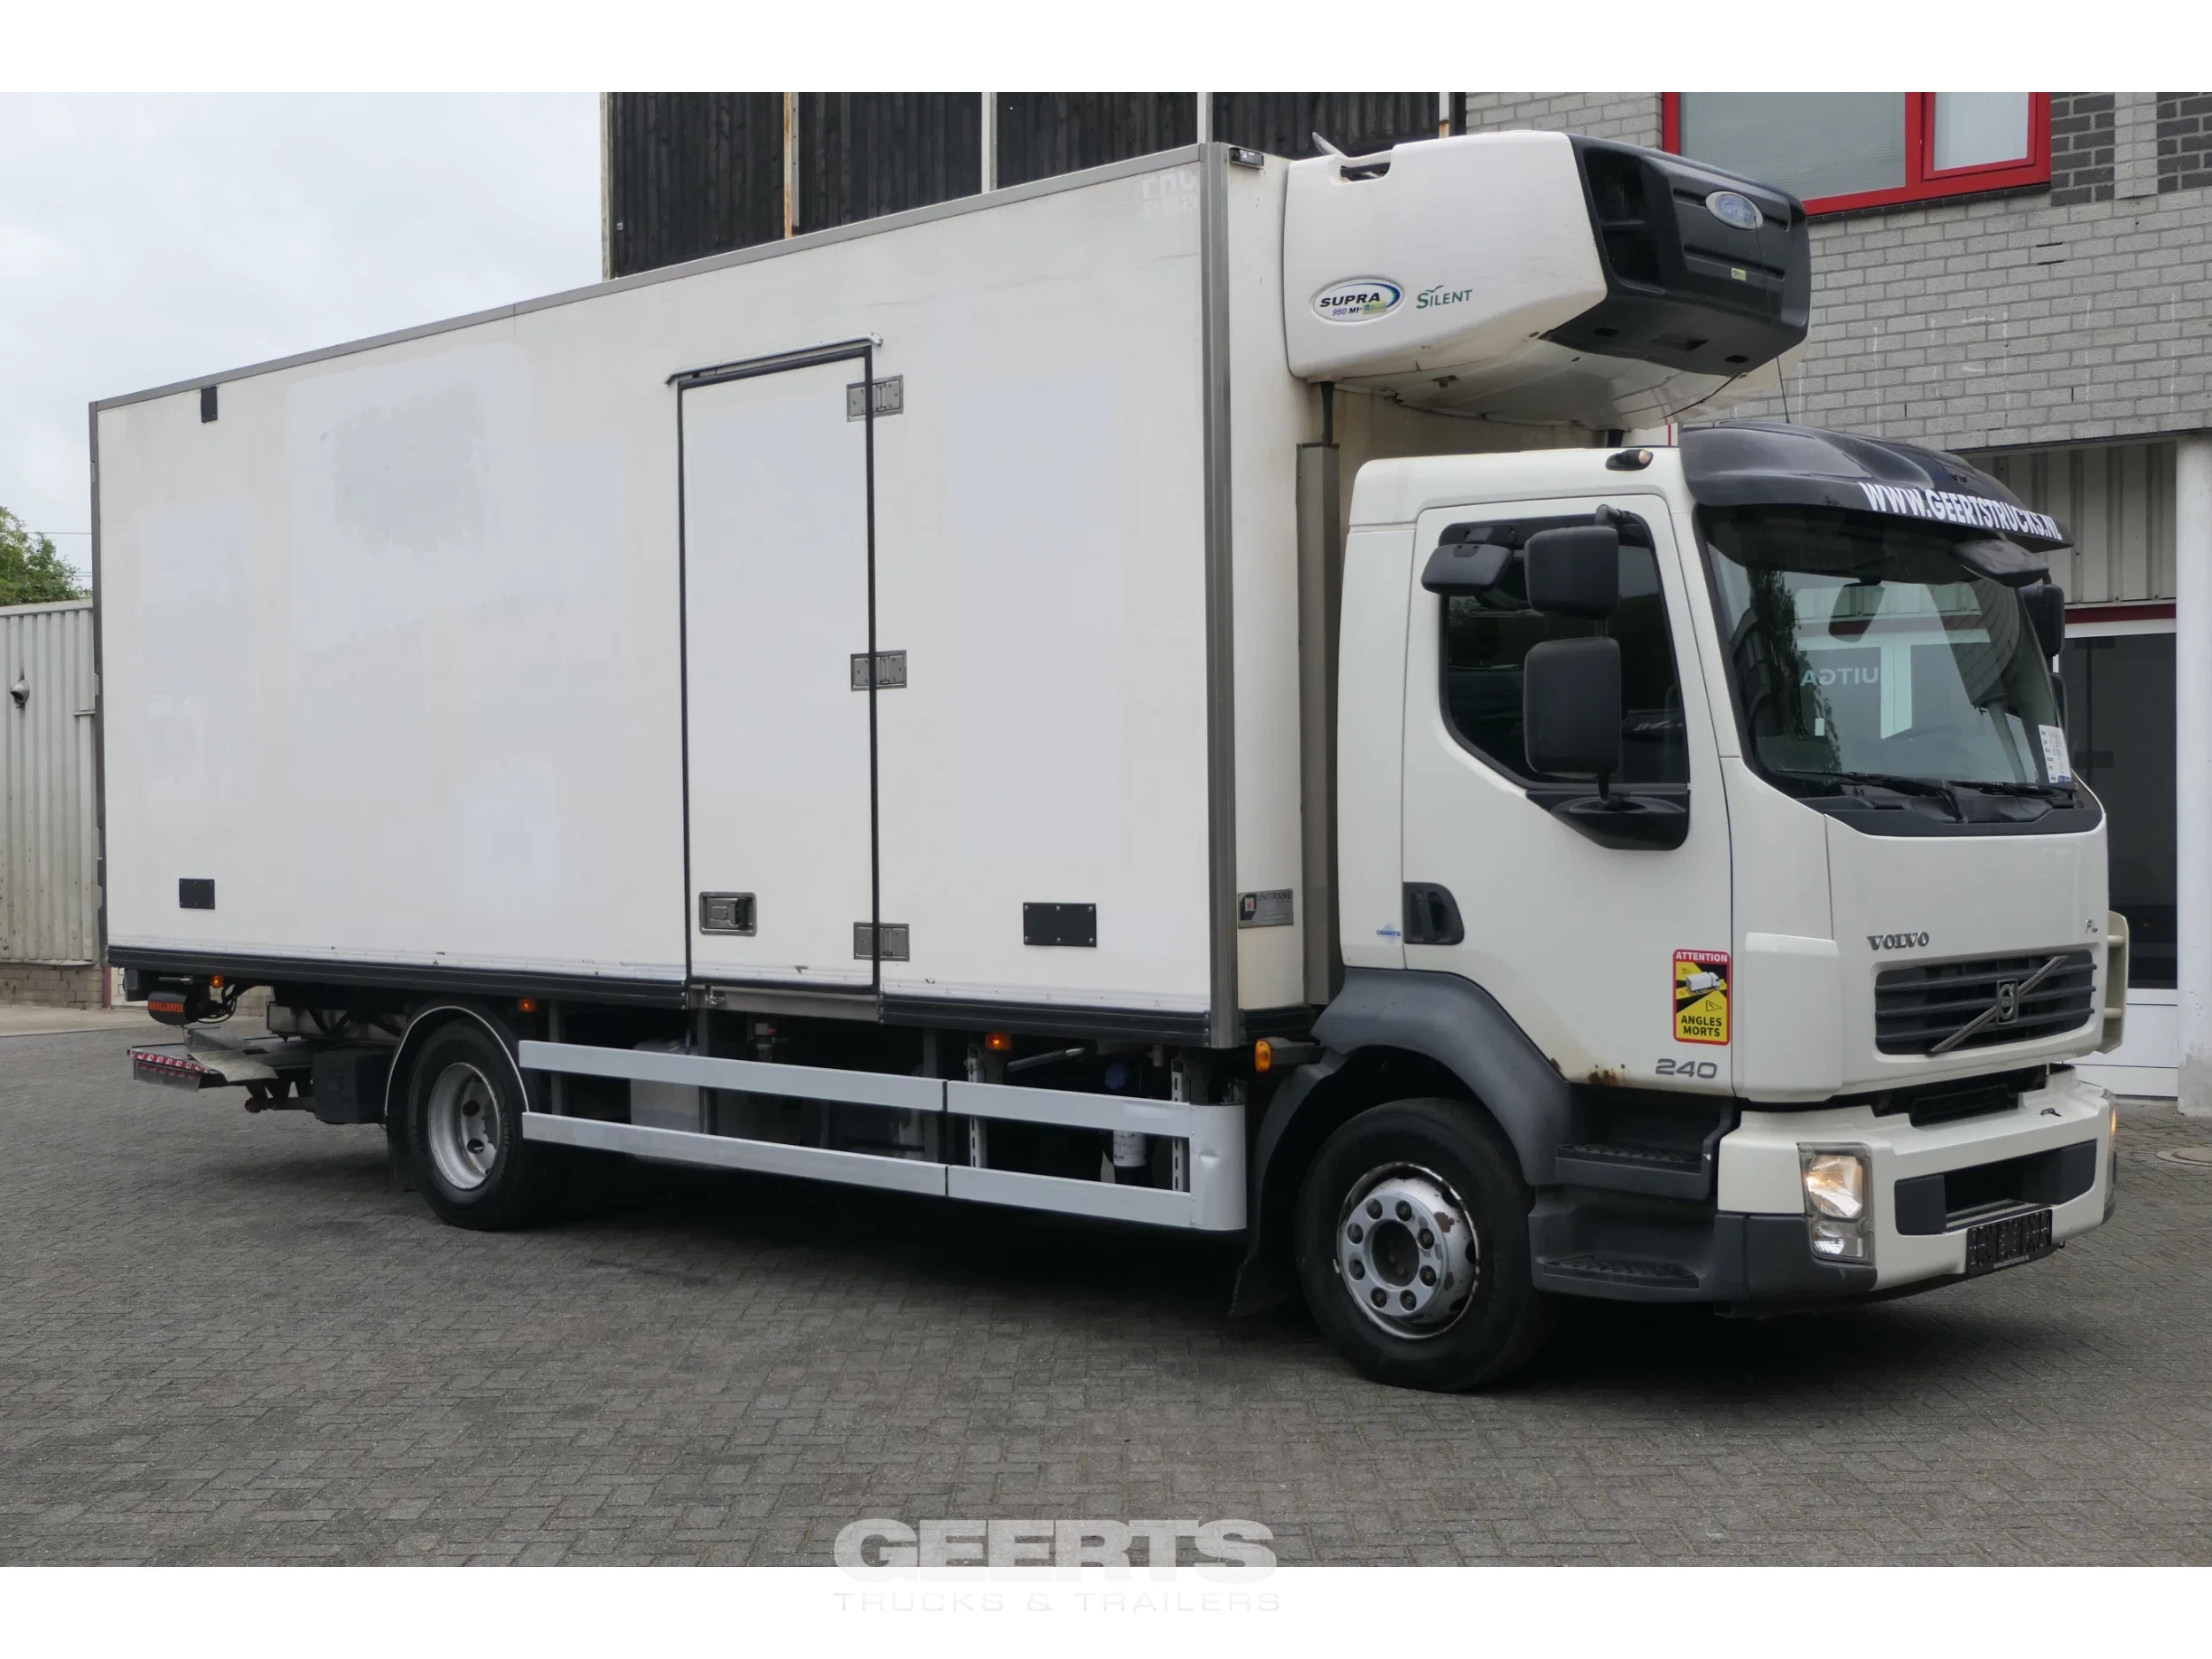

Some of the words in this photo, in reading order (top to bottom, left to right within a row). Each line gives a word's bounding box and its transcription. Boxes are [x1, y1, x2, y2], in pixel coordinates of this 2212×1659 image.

[1319, 292, 1380, 308] SUPRA
[1332, 308, 1348, 317] 950
[1858, 481, 2062, 541] WWW.GEERTSTRUCKS.NL
[2085, 918, 2098, 933] FL
[1867, 932, 1930, 950] VOLVO
[1676, 951, 1728, 962] ATTENTION
[1681, 1015, 1722, 1026] ANGLES
[1683, 1025, 1720, 1037] MORTS
[1655, 1058, 1717, 1079] 240
